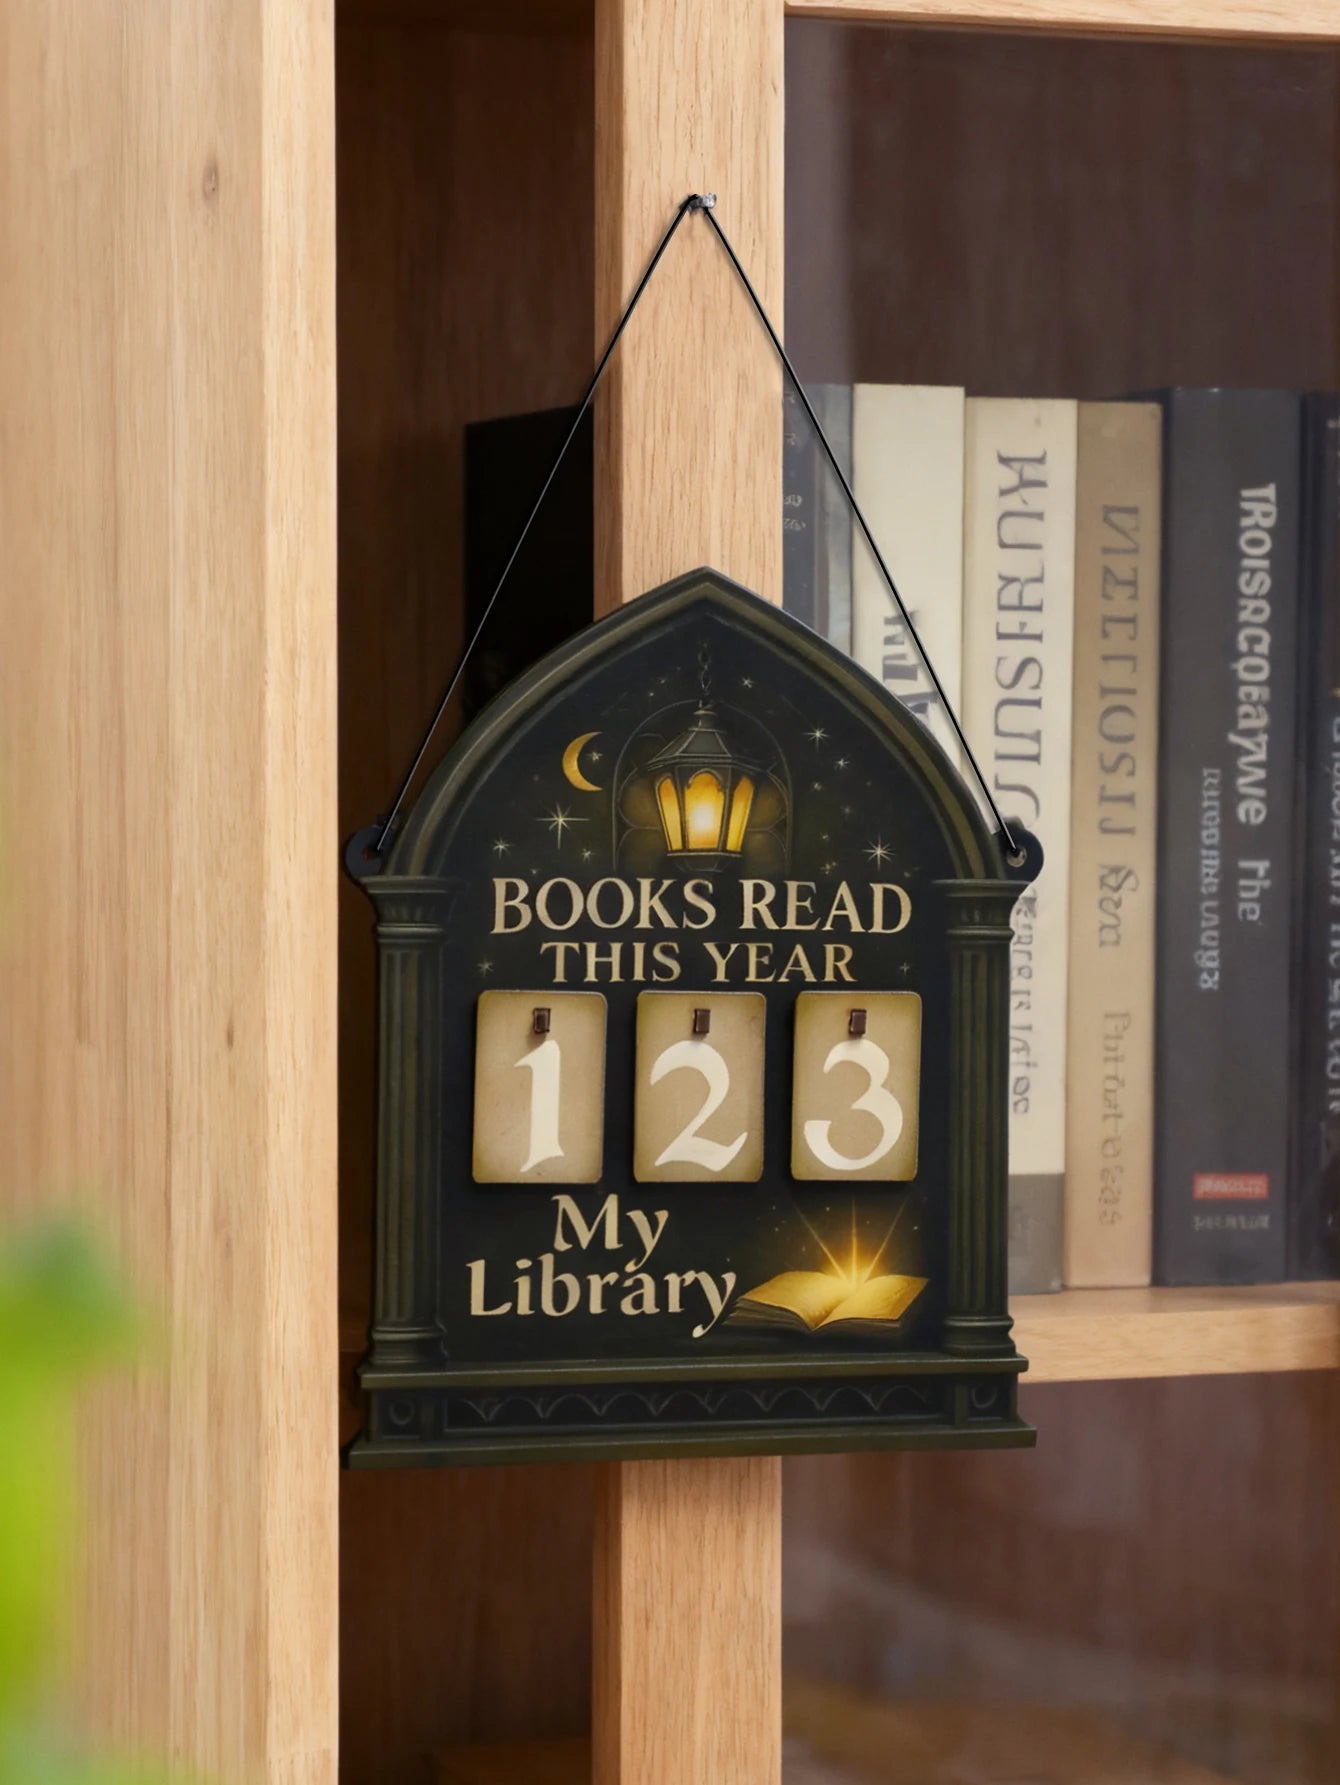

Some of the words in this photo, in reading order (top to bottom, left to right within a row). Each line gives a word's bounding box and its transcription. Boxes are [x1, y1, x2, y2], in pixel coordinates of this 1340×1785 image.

[490, 877, 717, 934] BOOKS
[738, 879, 912, 934] READ
[540, 941, 681, 983] THIS
[703, 942, 857, 983] YEAR
[514, 1039, 566, 1174] 1
[649, 1040, 749, 1173] 2
[804, 1039, 904, 1171] 3
[552, 1194, 669, 1273] My
[466, 1253, 737, 1338] Library
